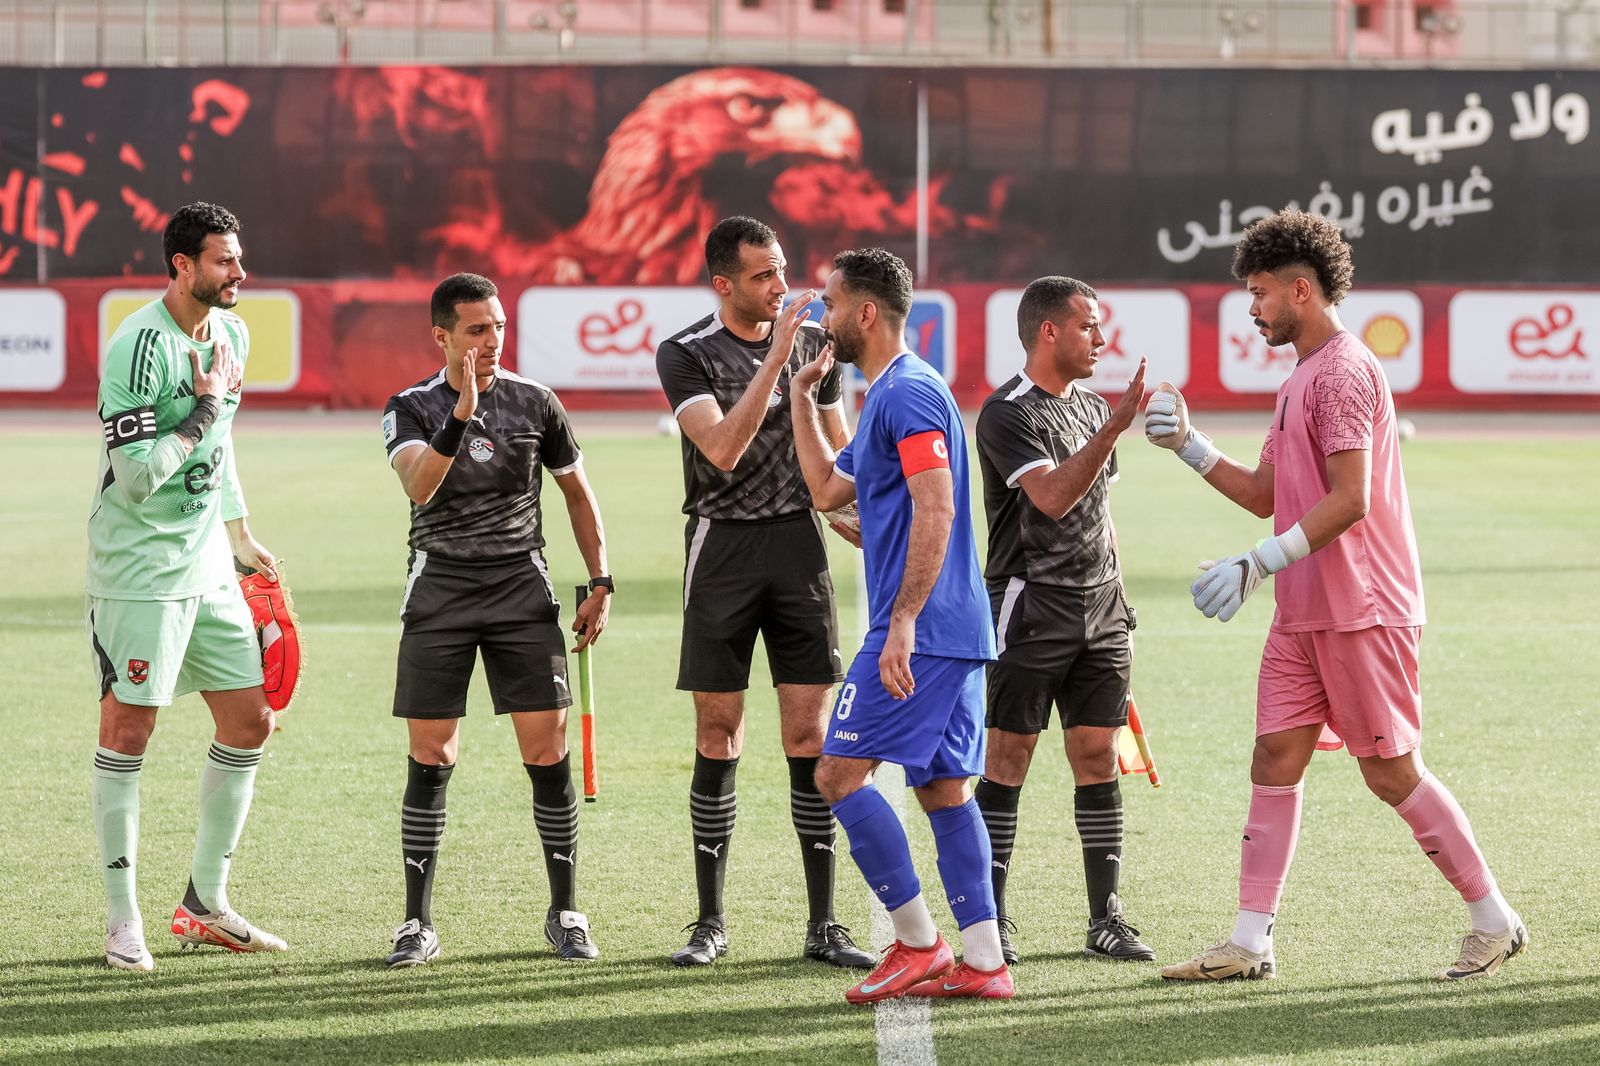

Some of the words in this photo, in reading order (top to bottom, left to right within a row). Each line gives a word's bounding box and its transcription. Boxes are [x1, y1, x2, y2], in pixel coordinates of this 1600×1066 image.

[1370, 92, 1495, 166] فيه
[1509, 82, 1591, 145] ولا
[1376, 165, 1493, 231] غيره
[180, 500, 203, 513] etisa
[836, 682, 857, 721] 8
[833, 730, 859, 742] JAKO
